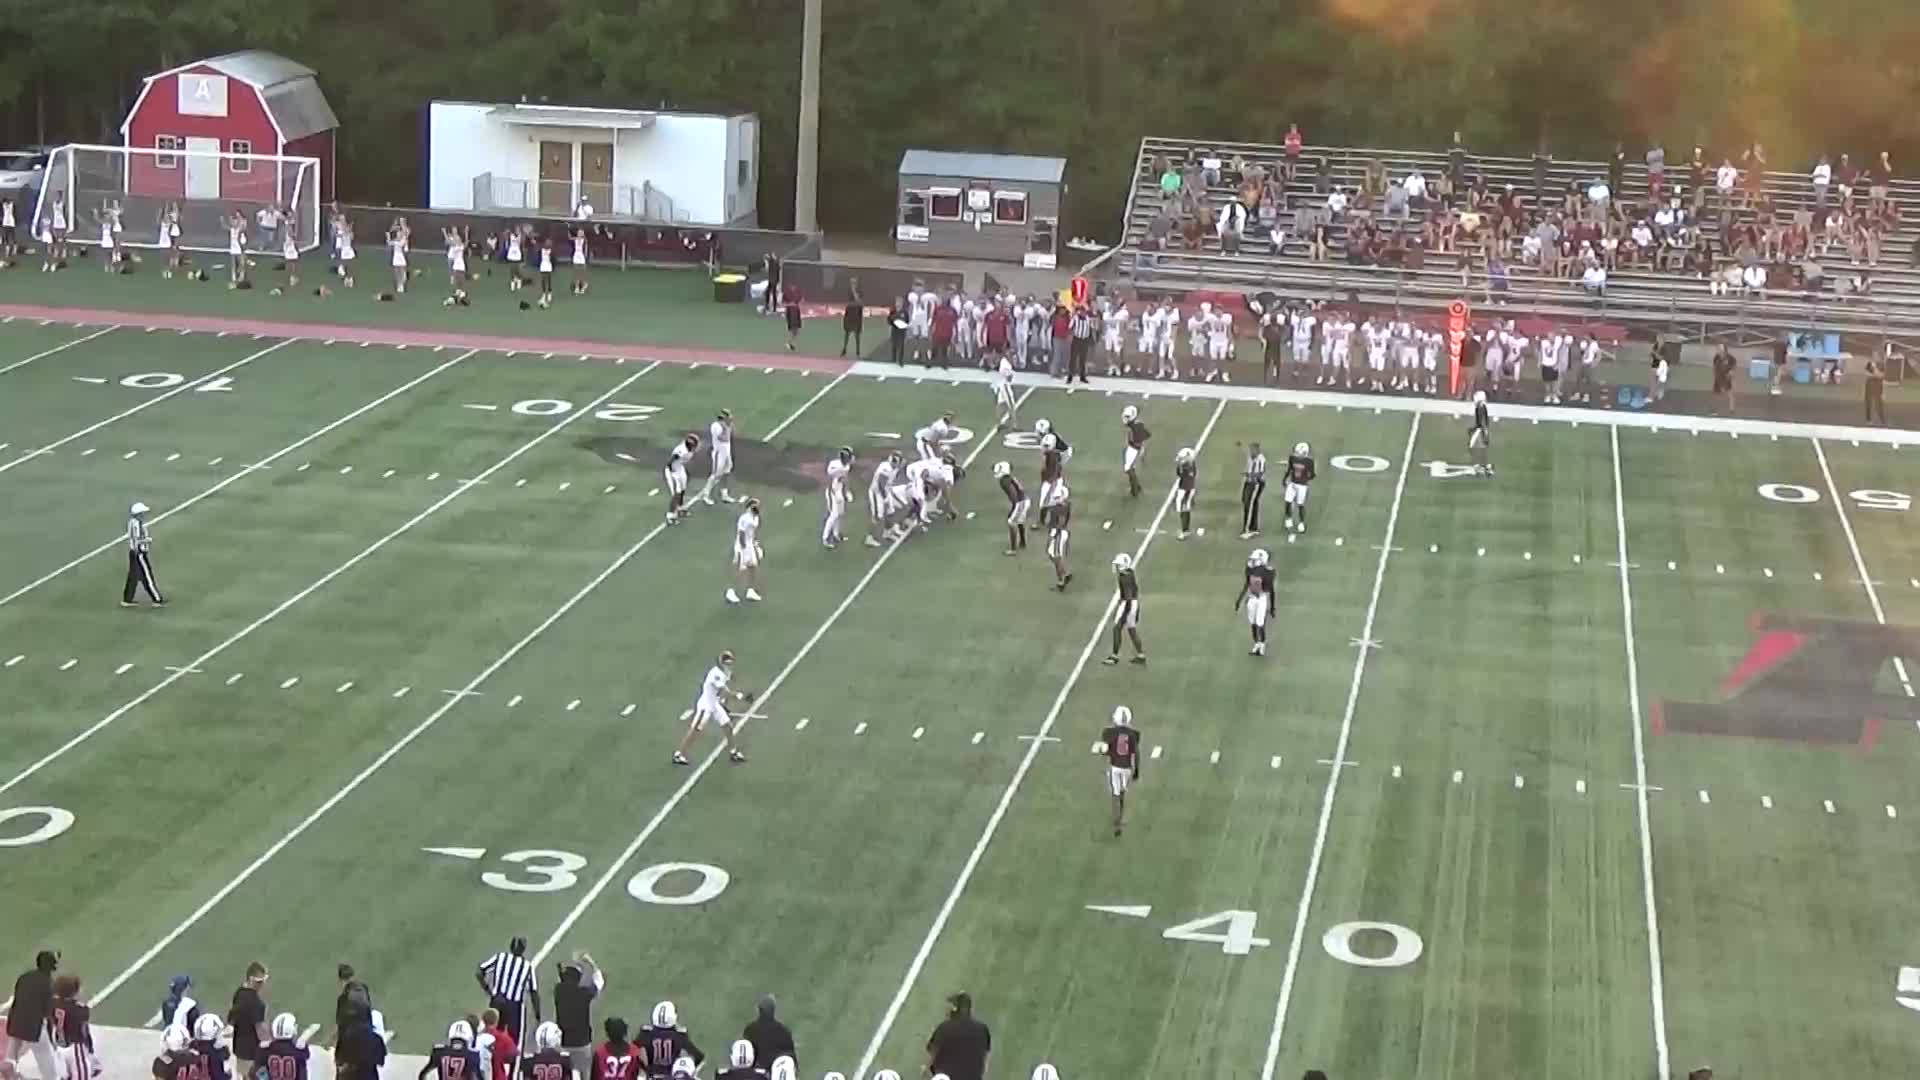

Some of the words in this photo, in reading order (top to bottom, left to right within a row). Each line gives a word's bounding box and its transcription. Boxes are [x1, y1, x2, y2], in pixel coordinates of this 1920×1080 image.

[194, 80, 210, 99] A
[481, 849, 730, 905] 30
[1162, 909, 1424, 967] 40
[652, 1038, 673, 1066] 11
[604, 1056, 632, 1079] 37
